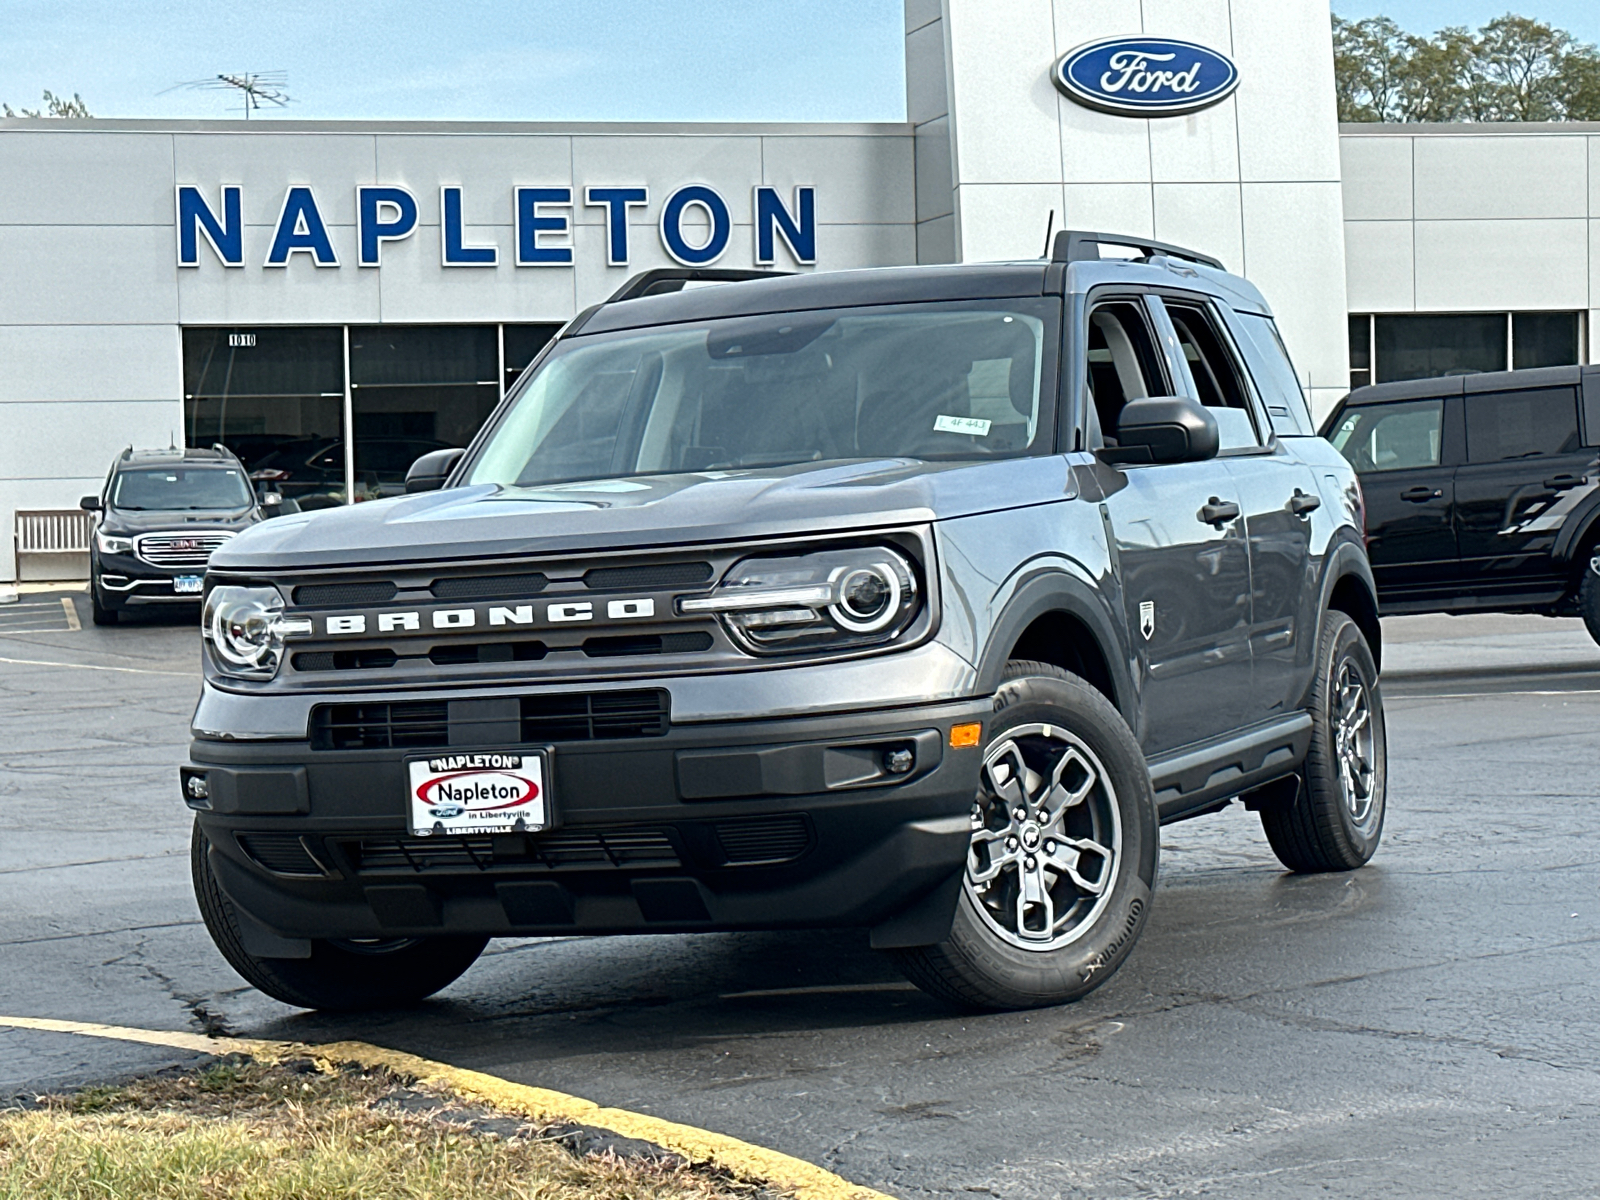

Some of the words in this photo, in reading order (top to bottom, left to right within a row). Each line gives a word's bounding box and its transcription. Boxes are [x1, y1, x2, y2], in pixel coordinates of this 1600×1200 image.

[1100, 51, 1202, 93] Ford
[176, 185, 817, 268] NAPLETON
[230, 334, 256, 346] 1010
[170, 540, 204, 549] GMC
[326, 598, 655, 635] BRONCO
[435, 755, 512, 771] NAPLETON
[438, 782, 520, 805] Napleton
[480, 810, 531, 820] Libertyville
[446, 826, 512, 835] LIBERTYVILLE
